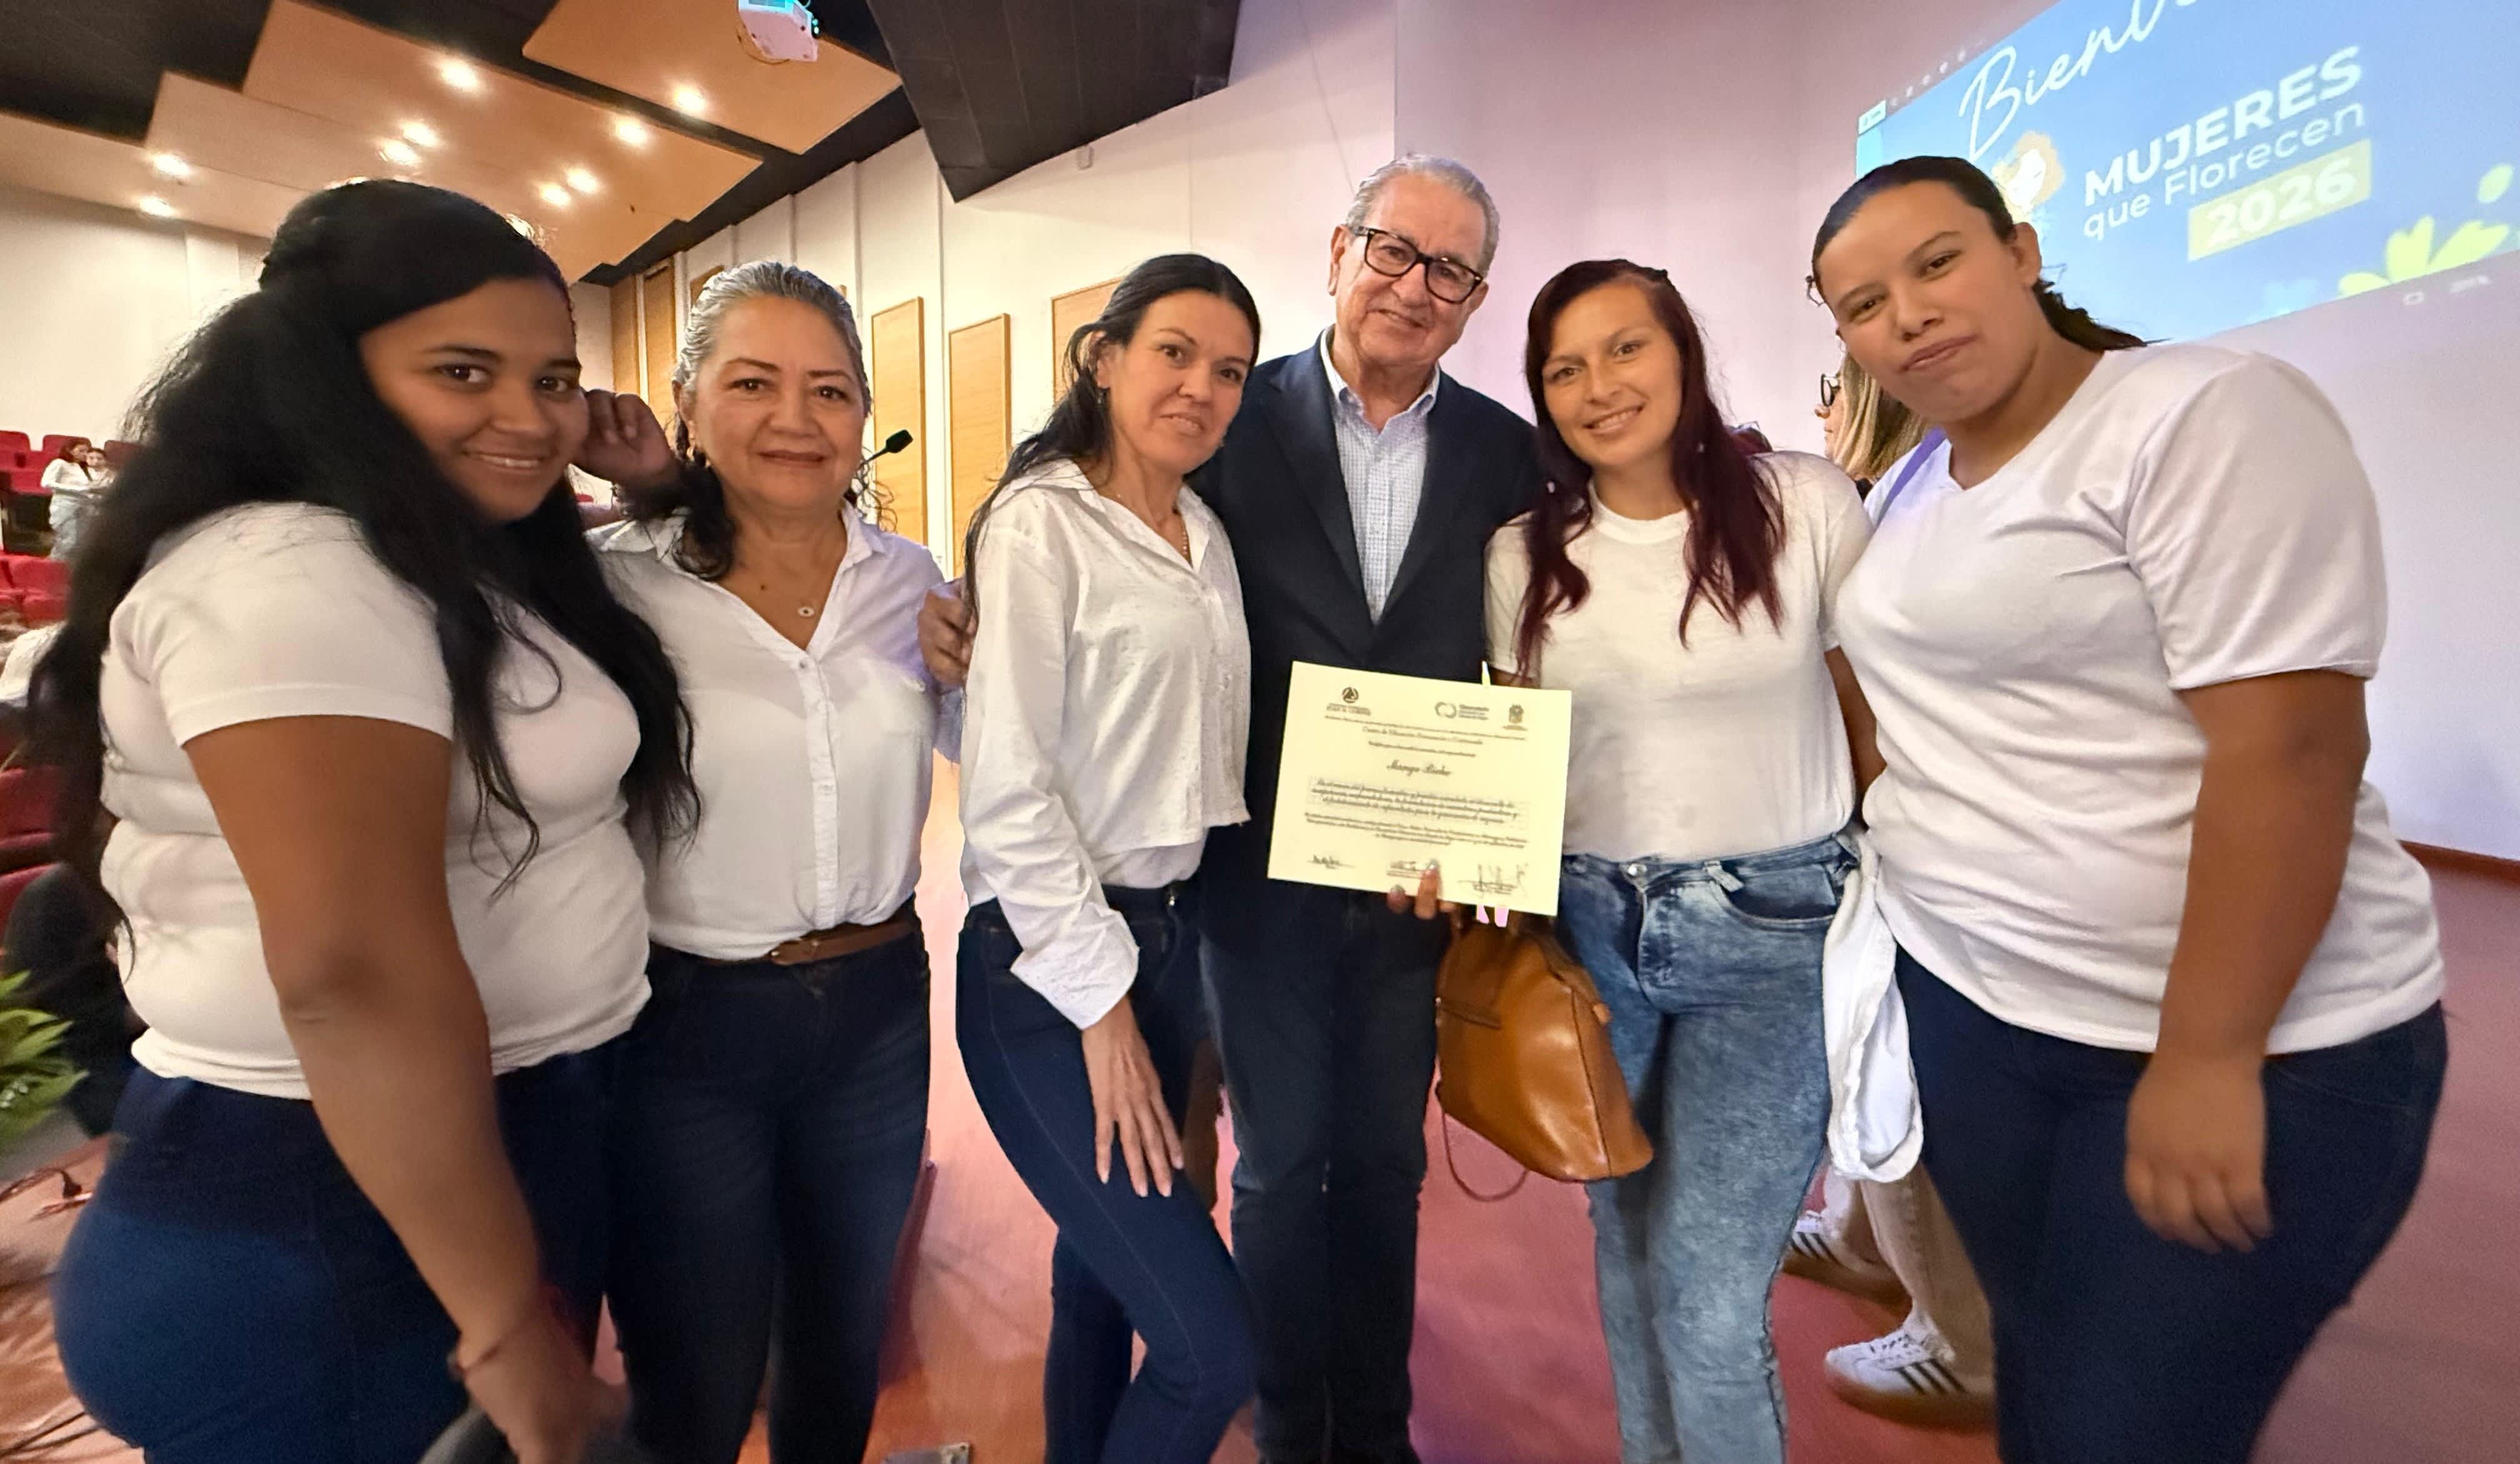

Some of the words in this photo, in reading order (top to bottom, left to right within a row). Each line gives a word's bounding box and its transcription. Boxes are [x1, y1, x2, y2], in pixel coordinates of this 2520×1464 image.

[1958, 0, 2198, 163] Bienv
[2084, 45, 2362, 207] MUJERES
[2083, 193, 2151, 241] que
[2164, 103, 2366, 206] Florecen
[2206, 158, 2358, 248] 2026
